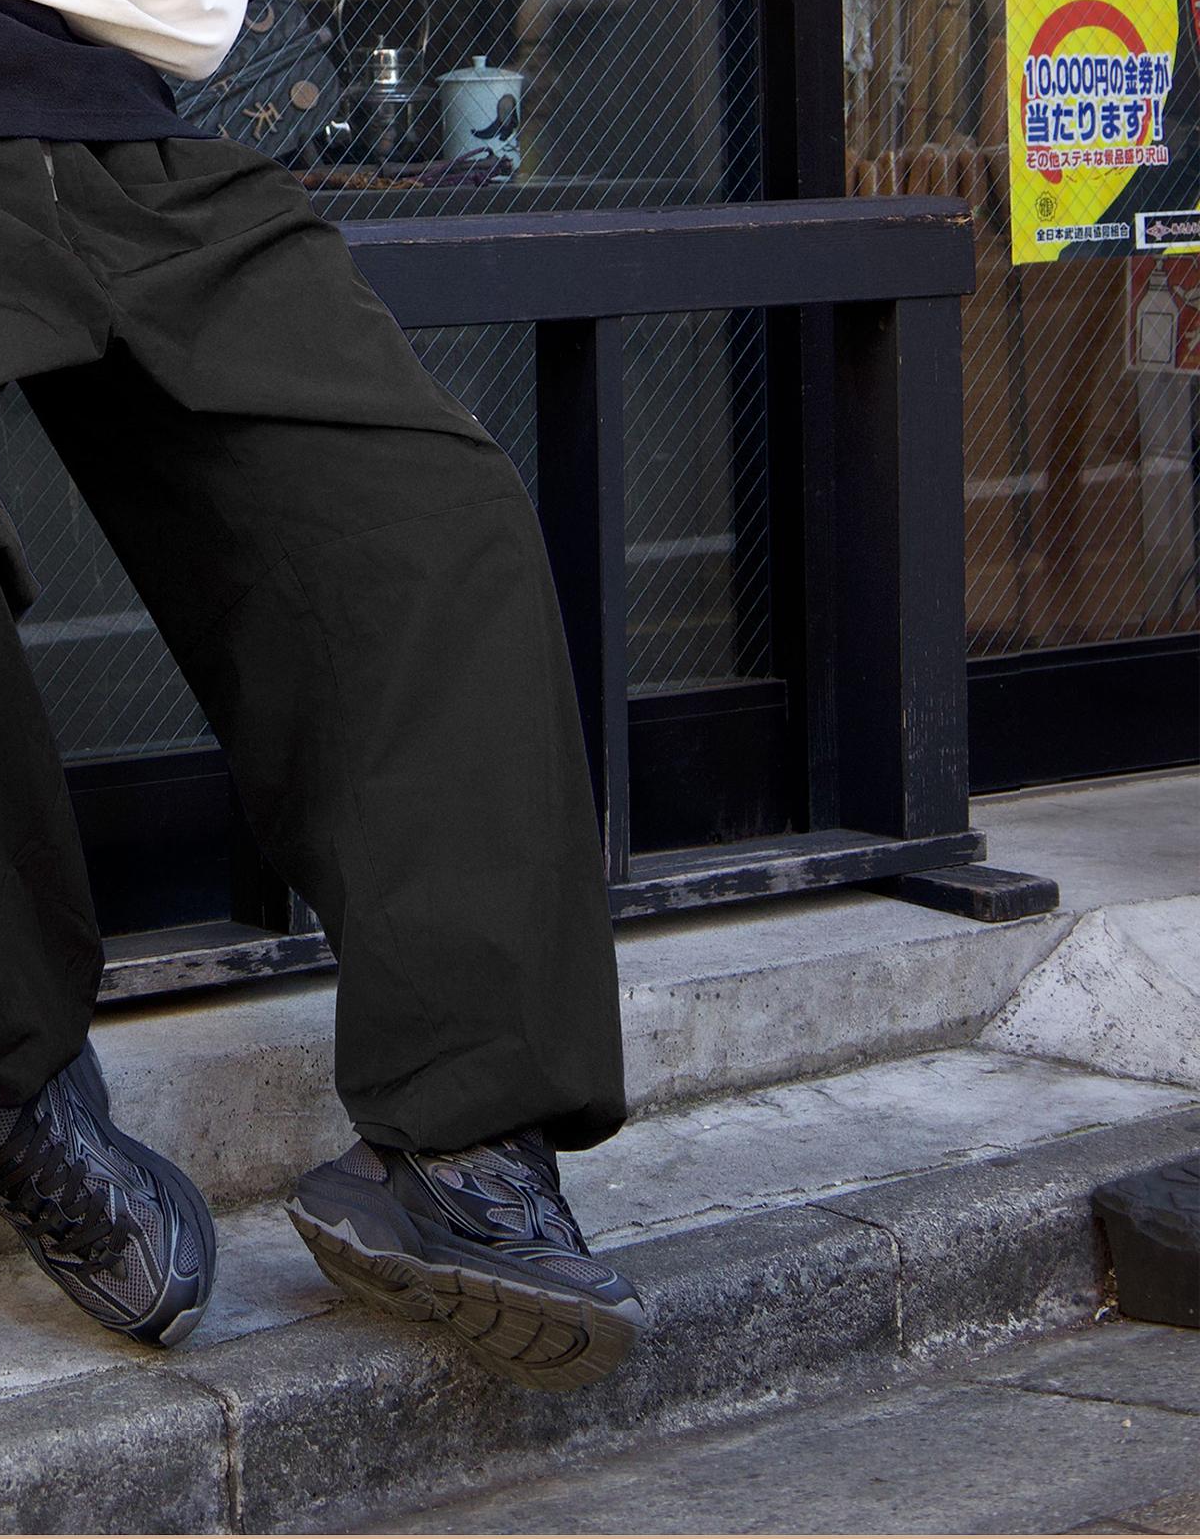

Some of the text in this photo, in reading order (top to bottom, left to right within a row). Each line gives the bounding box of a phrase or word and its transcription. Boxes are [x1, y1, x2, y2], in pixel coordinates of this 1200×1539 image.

[1024, 54, 1171, 98] 10,000円の金券が
[1027, 100, 1165, 142] 当たります!
[1026, 146, 1169, 170] その他ステキな景品盛り沢山
[1036, 223, 1131, 242] 全日本武道具協同組合
